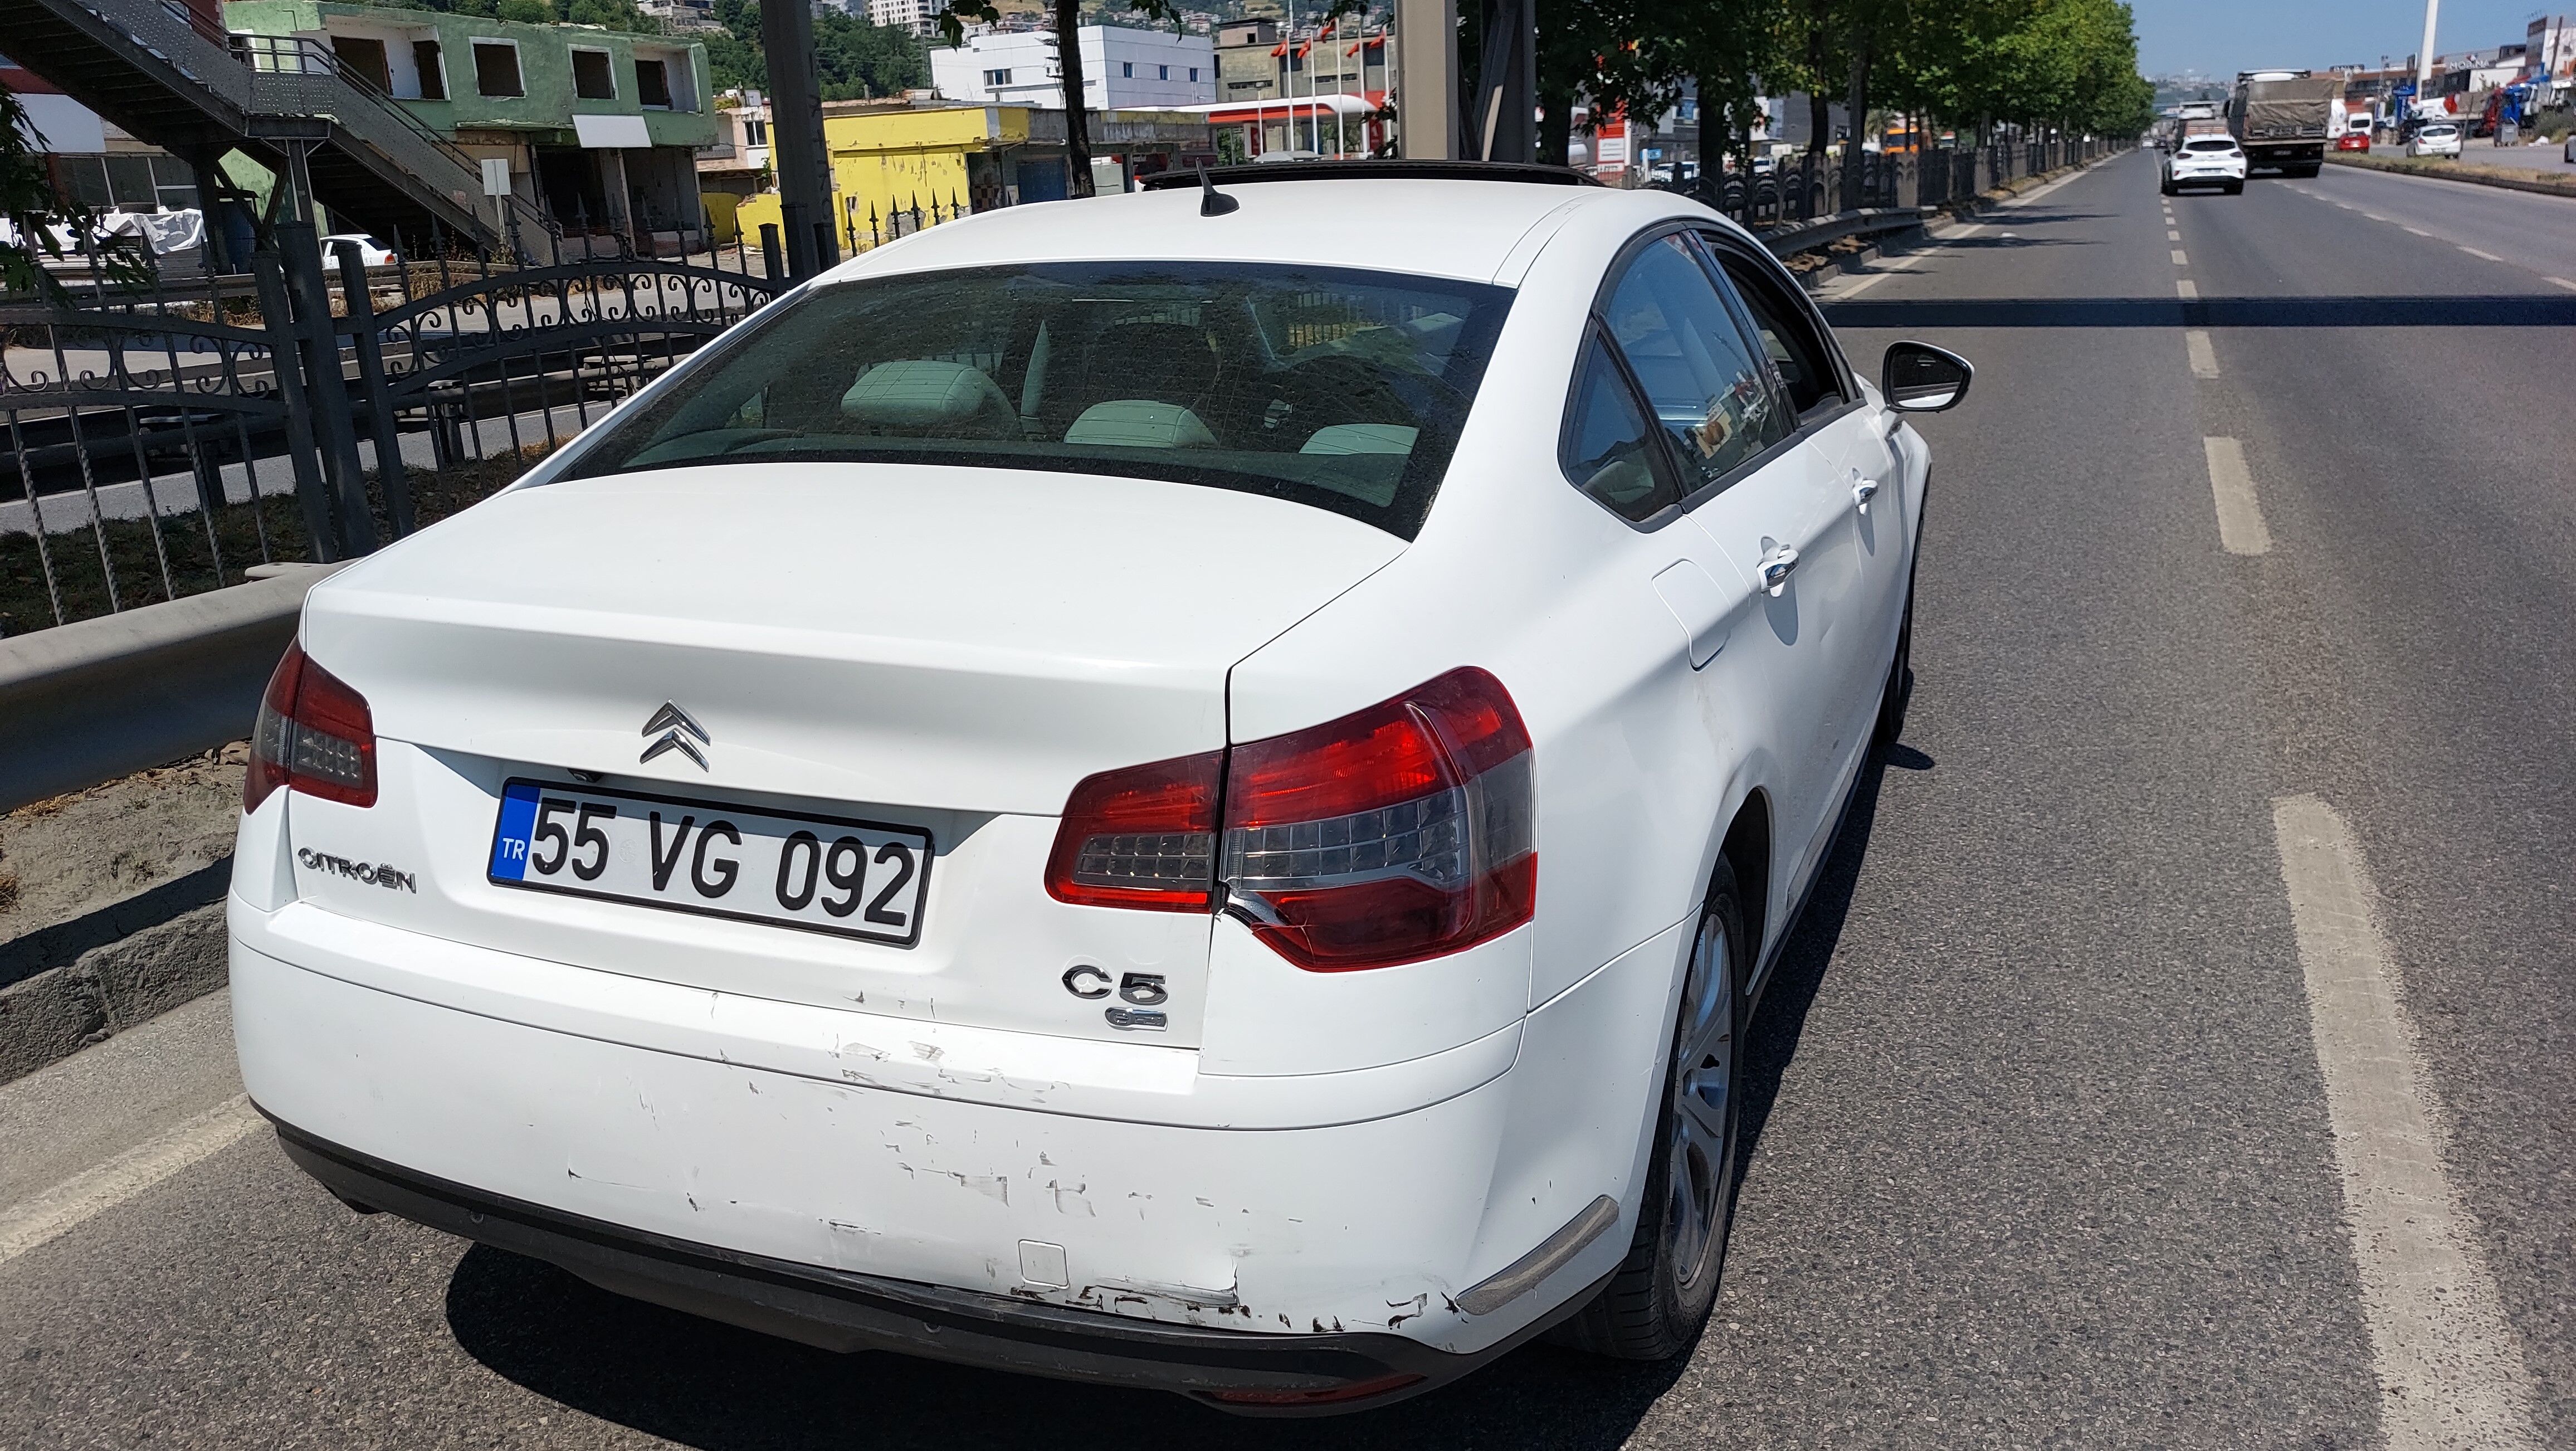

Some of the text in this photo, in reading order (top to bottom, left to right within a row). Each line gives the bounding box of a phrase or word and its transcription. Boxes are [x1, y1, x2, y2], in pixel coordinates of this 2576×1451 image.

[297, 846, 417, 894] CITROËN
[502, 838, 525, 860] TR
[532, 797, 915, 927] 55 VG 092
[1062, 964, 1168, 1006] C5
